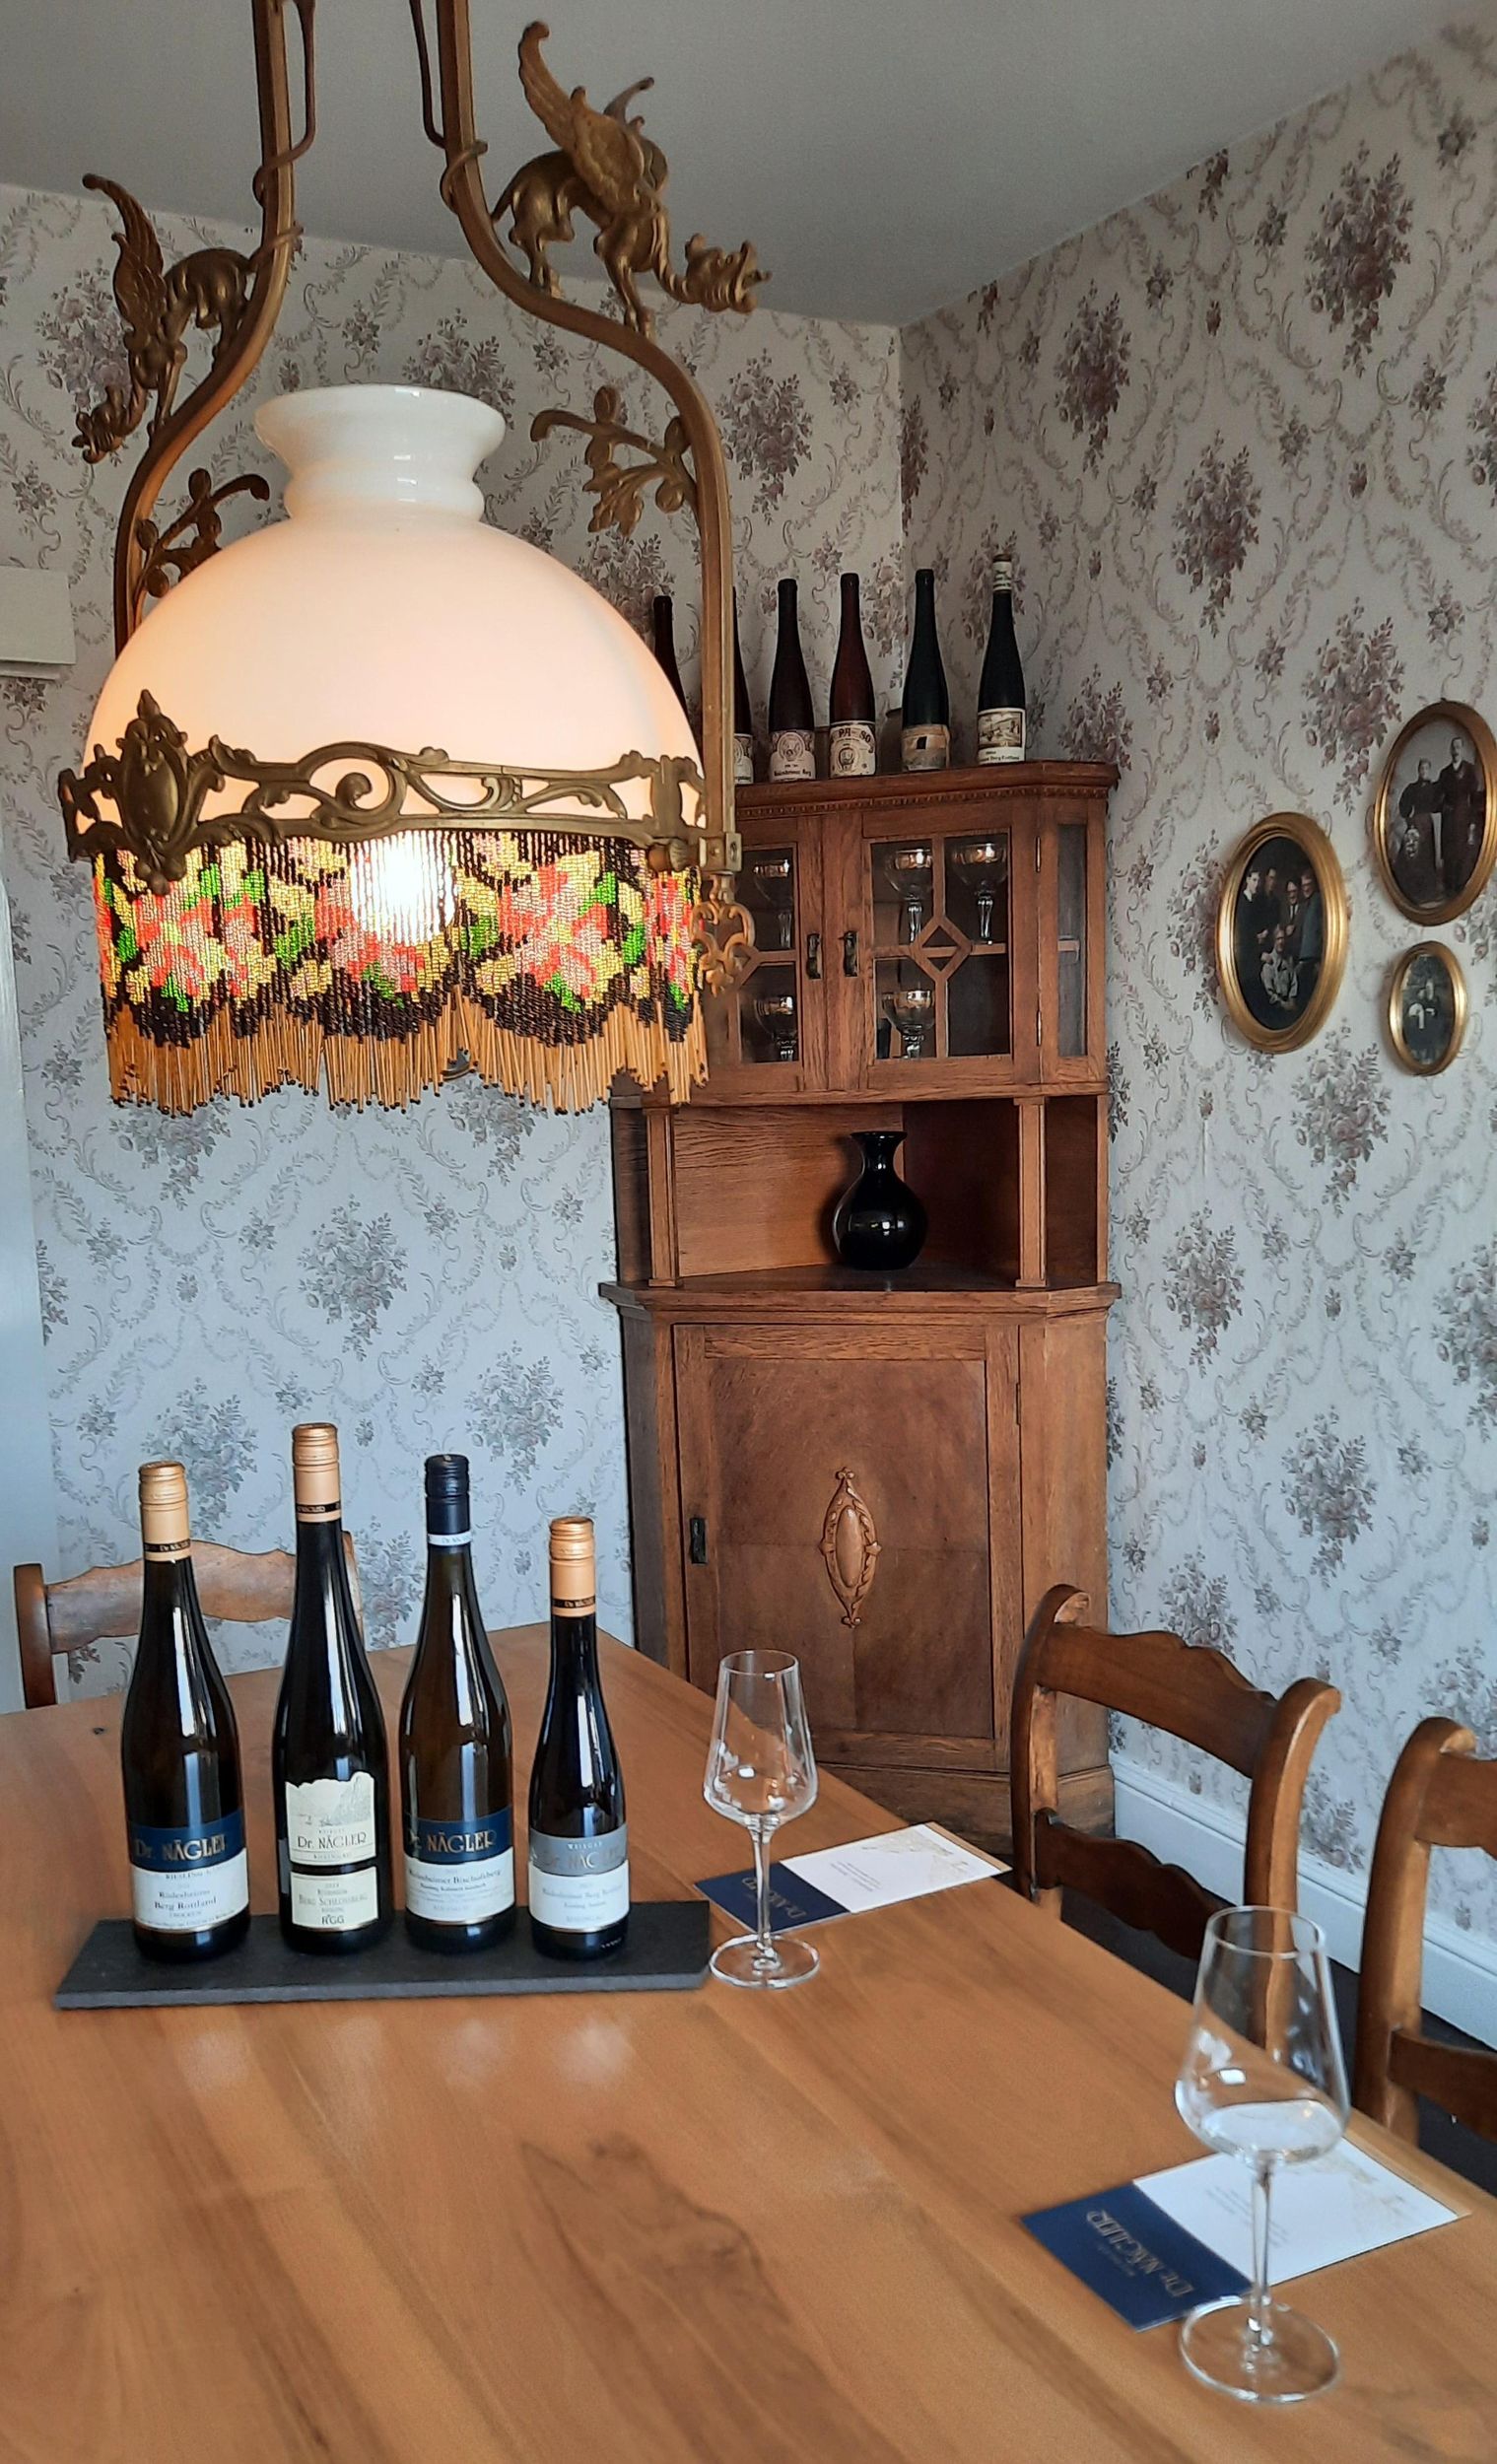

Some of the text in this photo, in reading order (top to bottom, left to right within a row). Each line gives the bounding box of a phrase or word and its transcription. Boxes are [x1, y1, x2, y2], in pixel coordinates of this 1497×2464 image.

[298, 1831, 367, 1850] Dr. NÄGLER
[427, 1829, 498, 1854] NÄGLER
